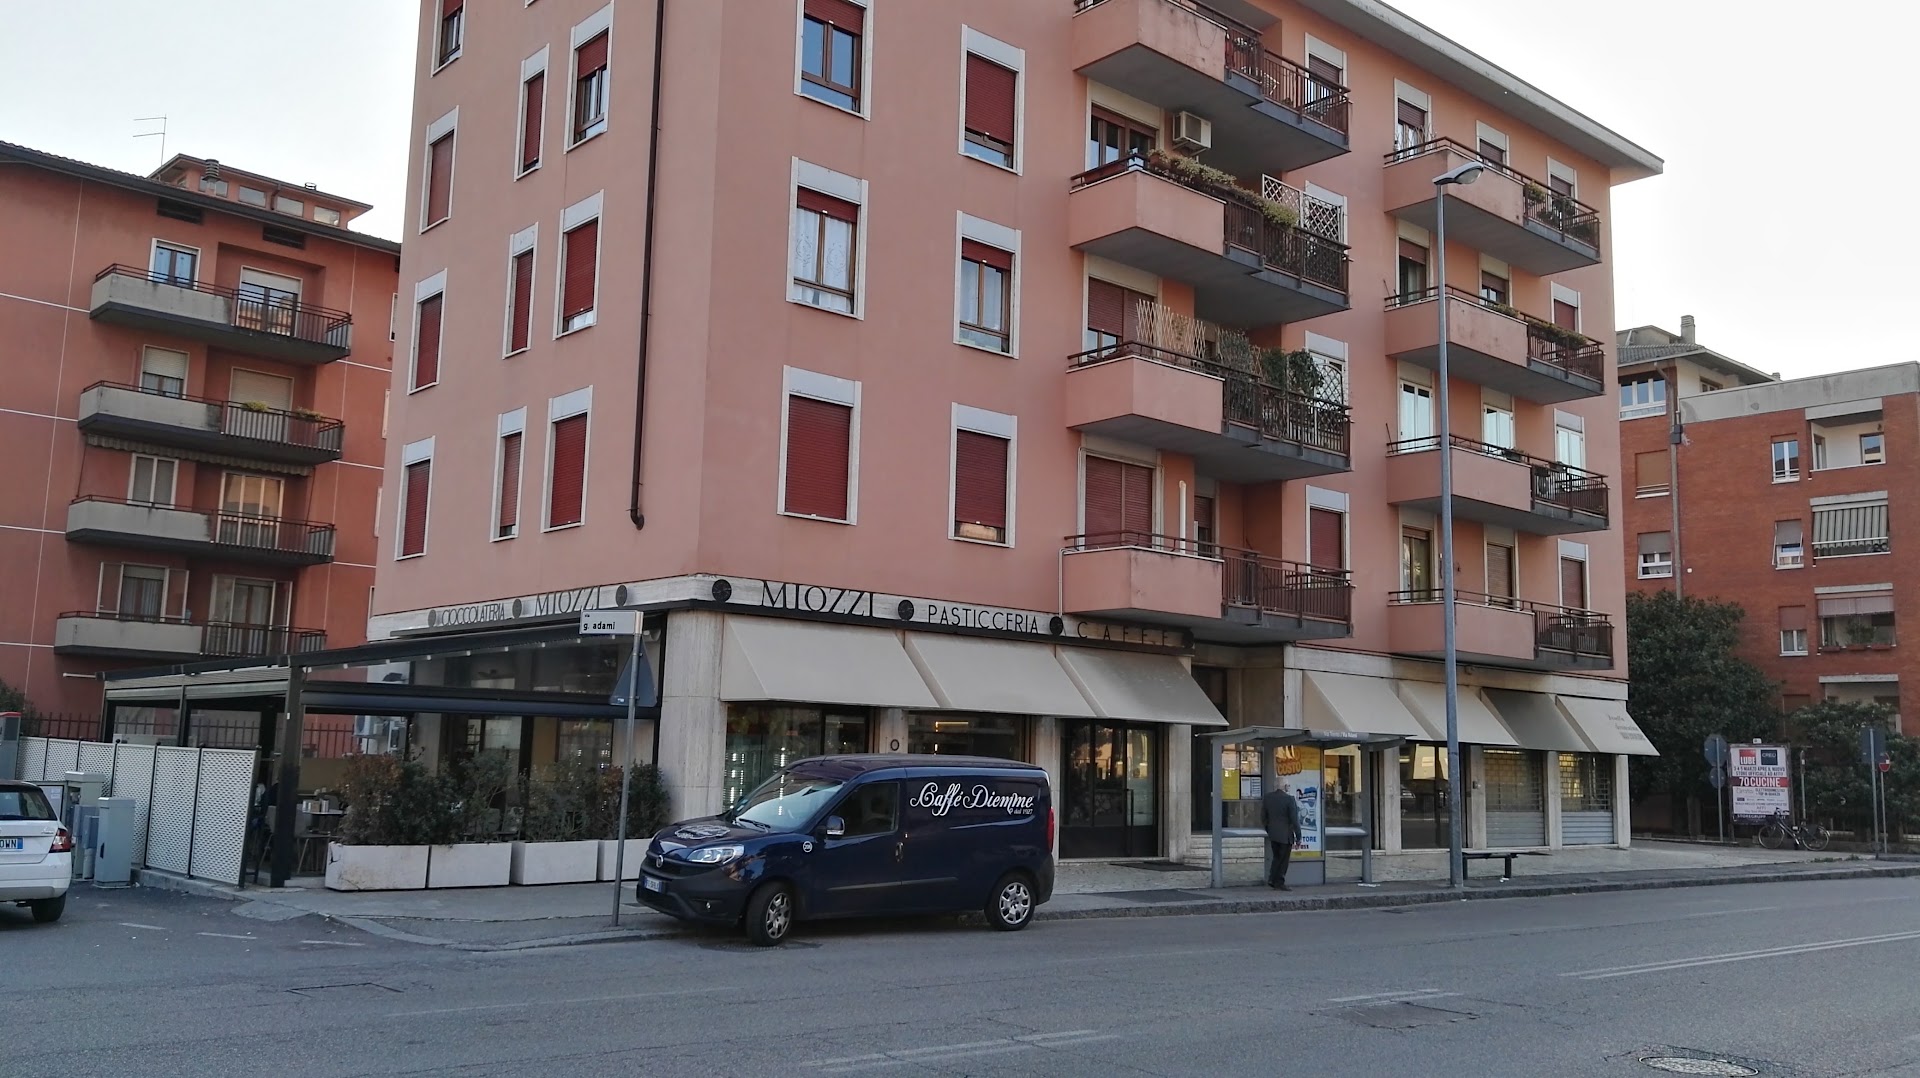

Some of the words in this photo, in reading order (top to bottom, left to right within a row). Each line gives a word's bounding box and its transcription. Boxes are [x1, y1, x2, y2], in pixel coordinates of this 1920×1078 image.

[534, 586, 601, 617] MIOZZI
[762, 580, 873, 617] MIOZZI
[592, 621, 616, 630] adami
[928, 604, 1039, 634] PASTICCERIA
[1277, 761, 1302, 775] COSTO
[1740, 756, 1756, 765] LUBE
[1750, 777, 1781, 787] CUCINE
[962, 784, 1035, 816] Diemme
